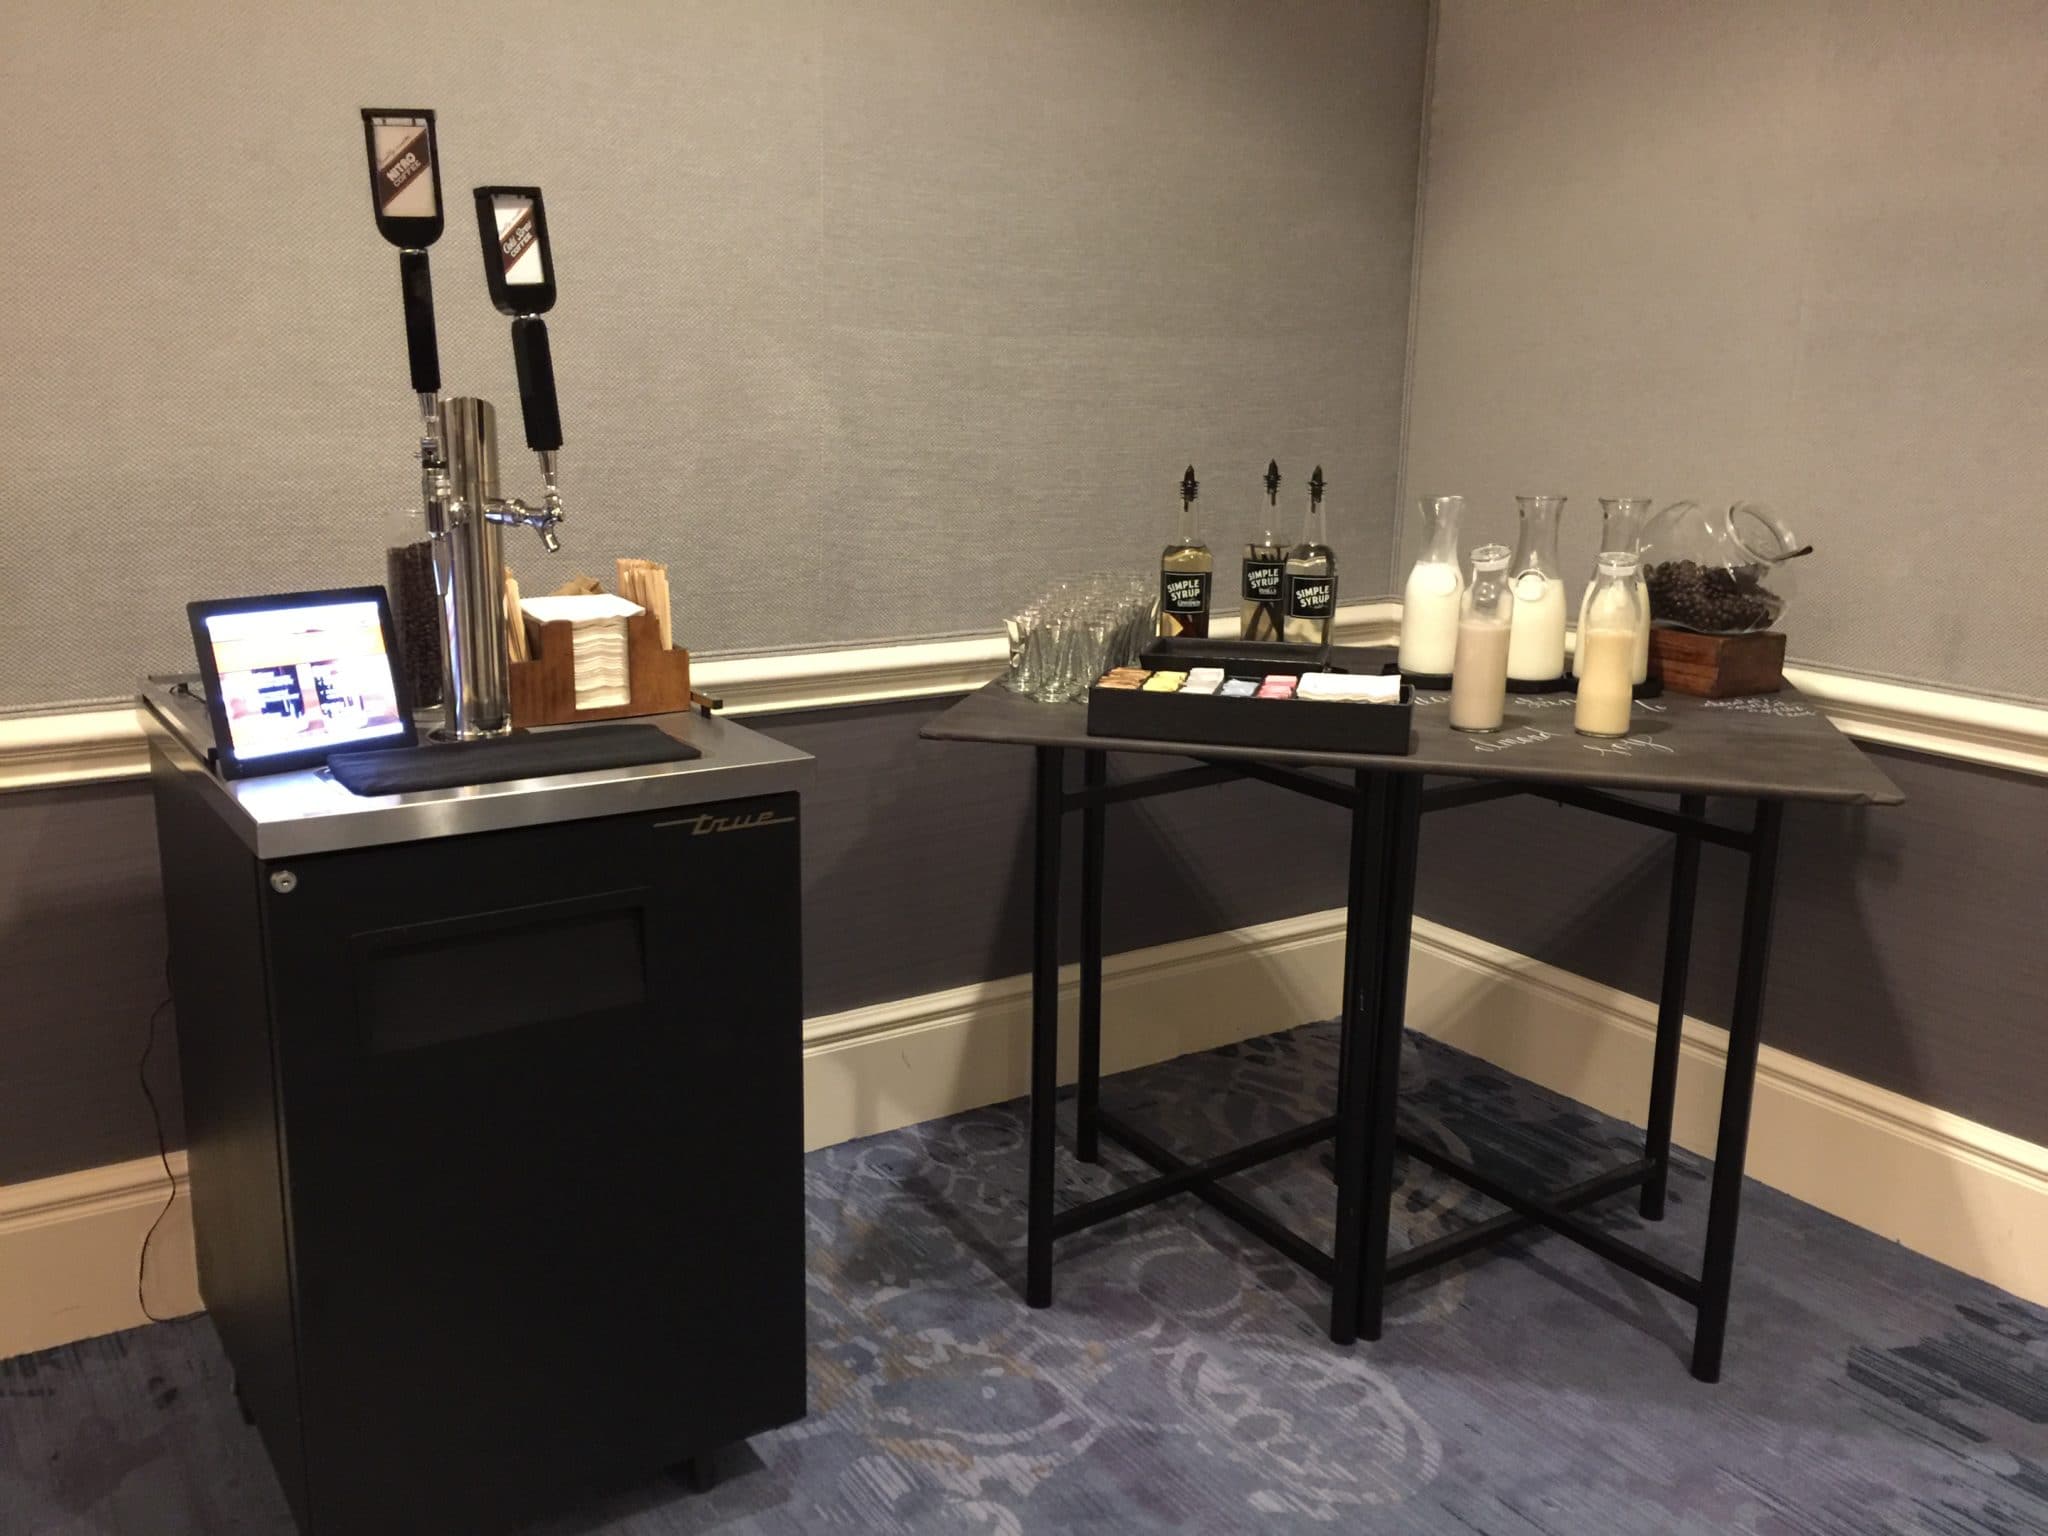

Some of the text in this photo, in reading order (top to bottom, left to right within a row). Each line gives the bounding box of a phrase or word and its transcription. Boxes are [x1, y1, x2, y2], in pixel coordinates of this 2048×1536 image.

[386, 152, 416, 182] NITRO
[1247, 568, 1279, 581] SIMPLE
[1166, 579, 1200, 593] SIMPLE
[1250, 576, 1280, 589] SYRUP
[1170, 588, 1201, 602] SYRUP
[1295, 585, 1330, 599] SIMPLE
[1299, 594, 1330, 608] SYRUP
[1468, 724, 1562, 752] almond
